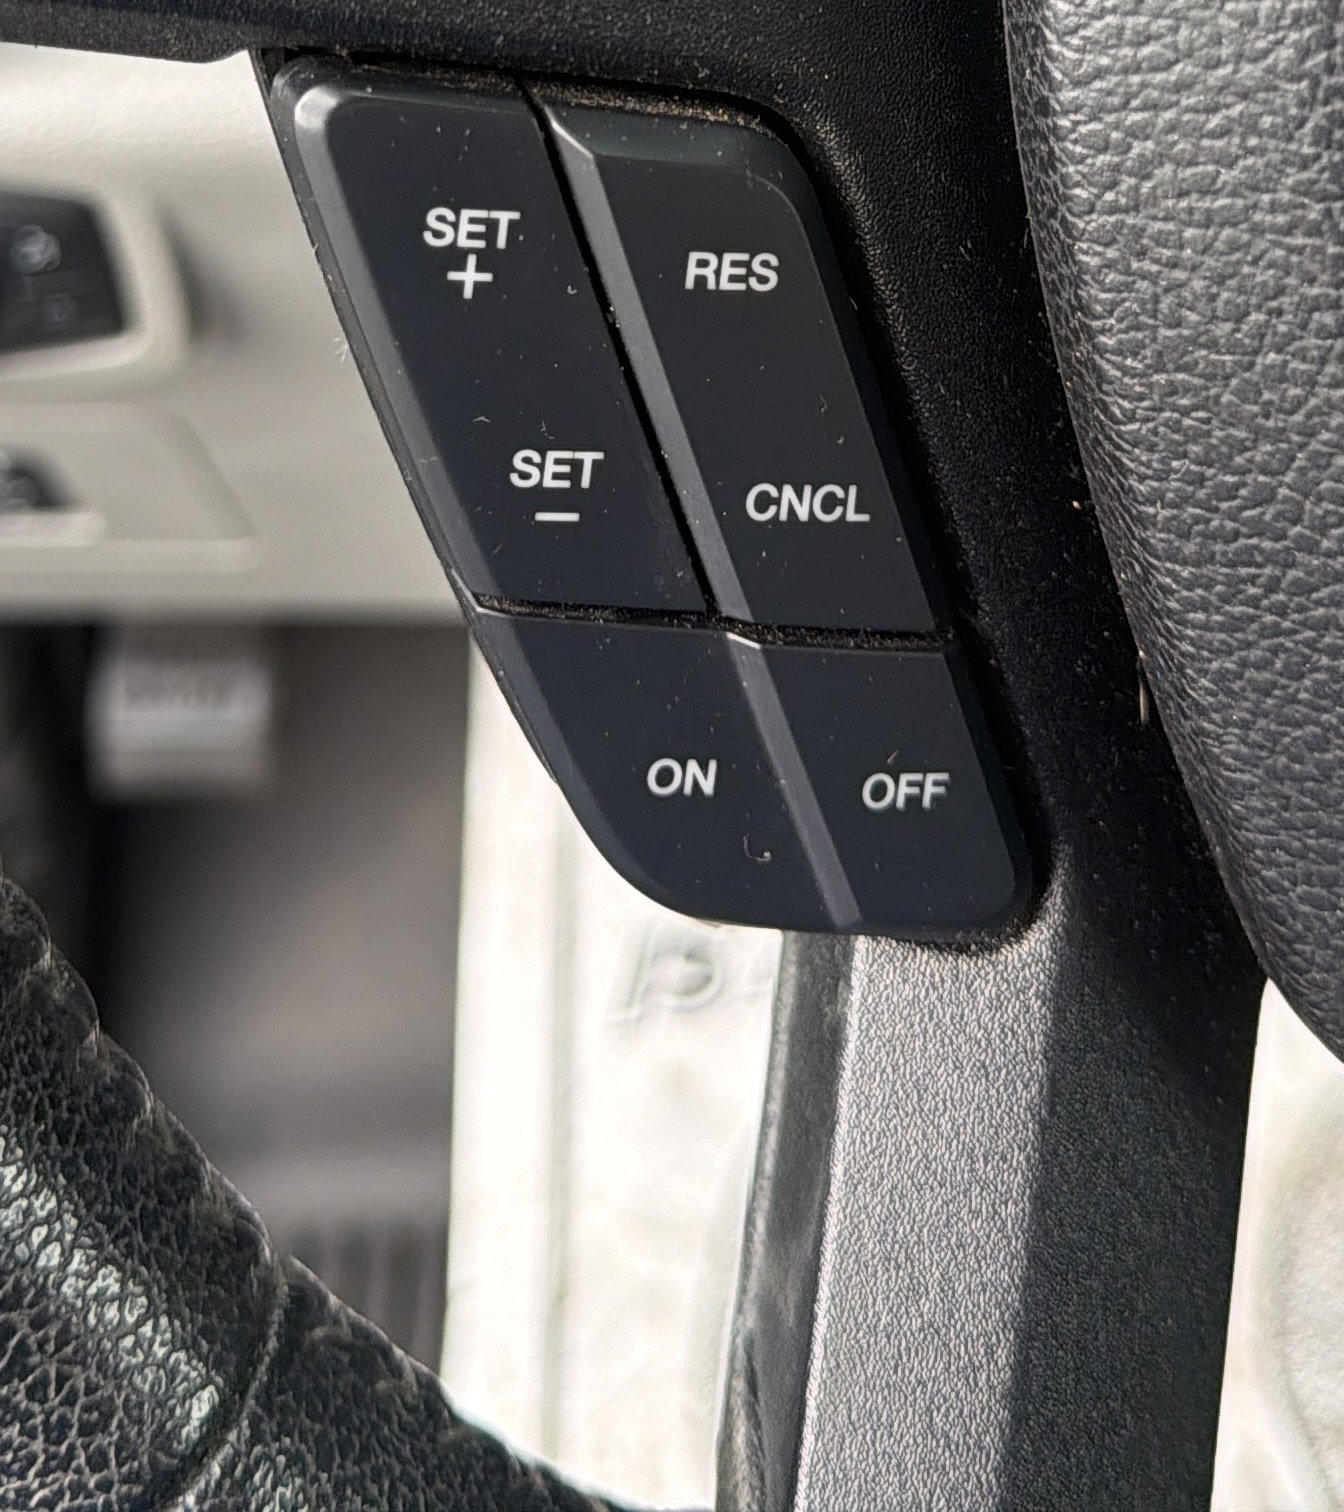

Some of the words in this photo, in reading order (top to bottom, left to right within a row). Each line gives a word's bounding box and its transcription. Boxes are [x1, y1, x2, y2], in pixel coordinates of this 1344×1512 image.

[422, 205, 522, 250] SET
[683, 250, 781, 293] RES
[508, 448, 606, 490] SET
[744, 481, 871, 524] CNCL
[645, 757, 718, 797] ON
[861, 771, 950, 811] OFF
